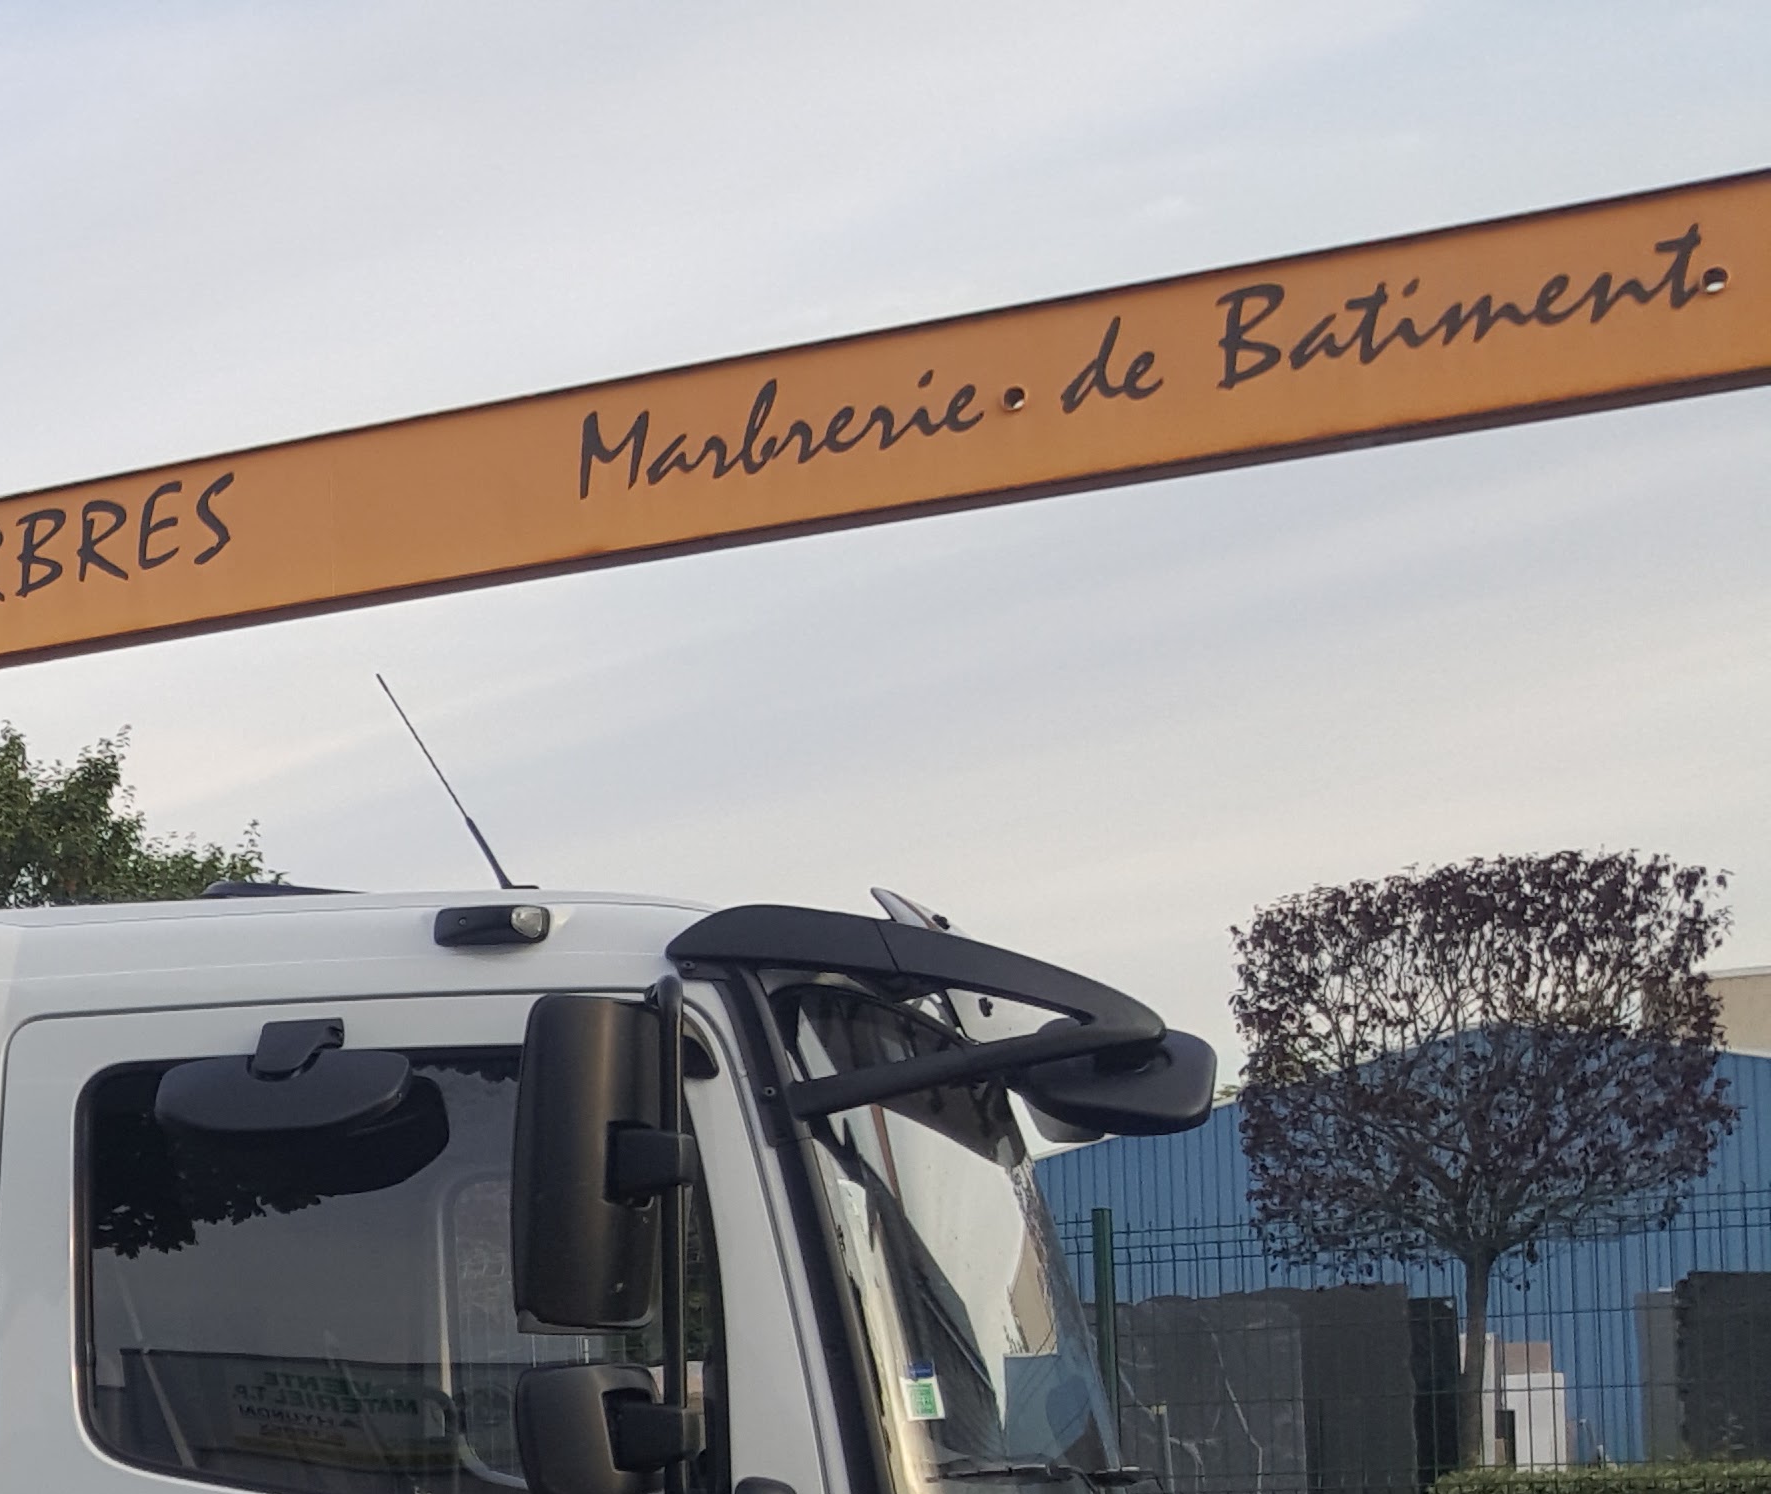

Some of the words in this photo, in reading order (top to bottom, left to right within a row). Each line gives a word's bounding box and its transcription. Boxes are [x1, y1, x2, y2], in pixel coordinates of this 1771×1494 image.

[576, 380, 985, 500] Marbrerie
[1060, 316, 1163, 414] de
[1215, 222, 1703, 390] Batiment
